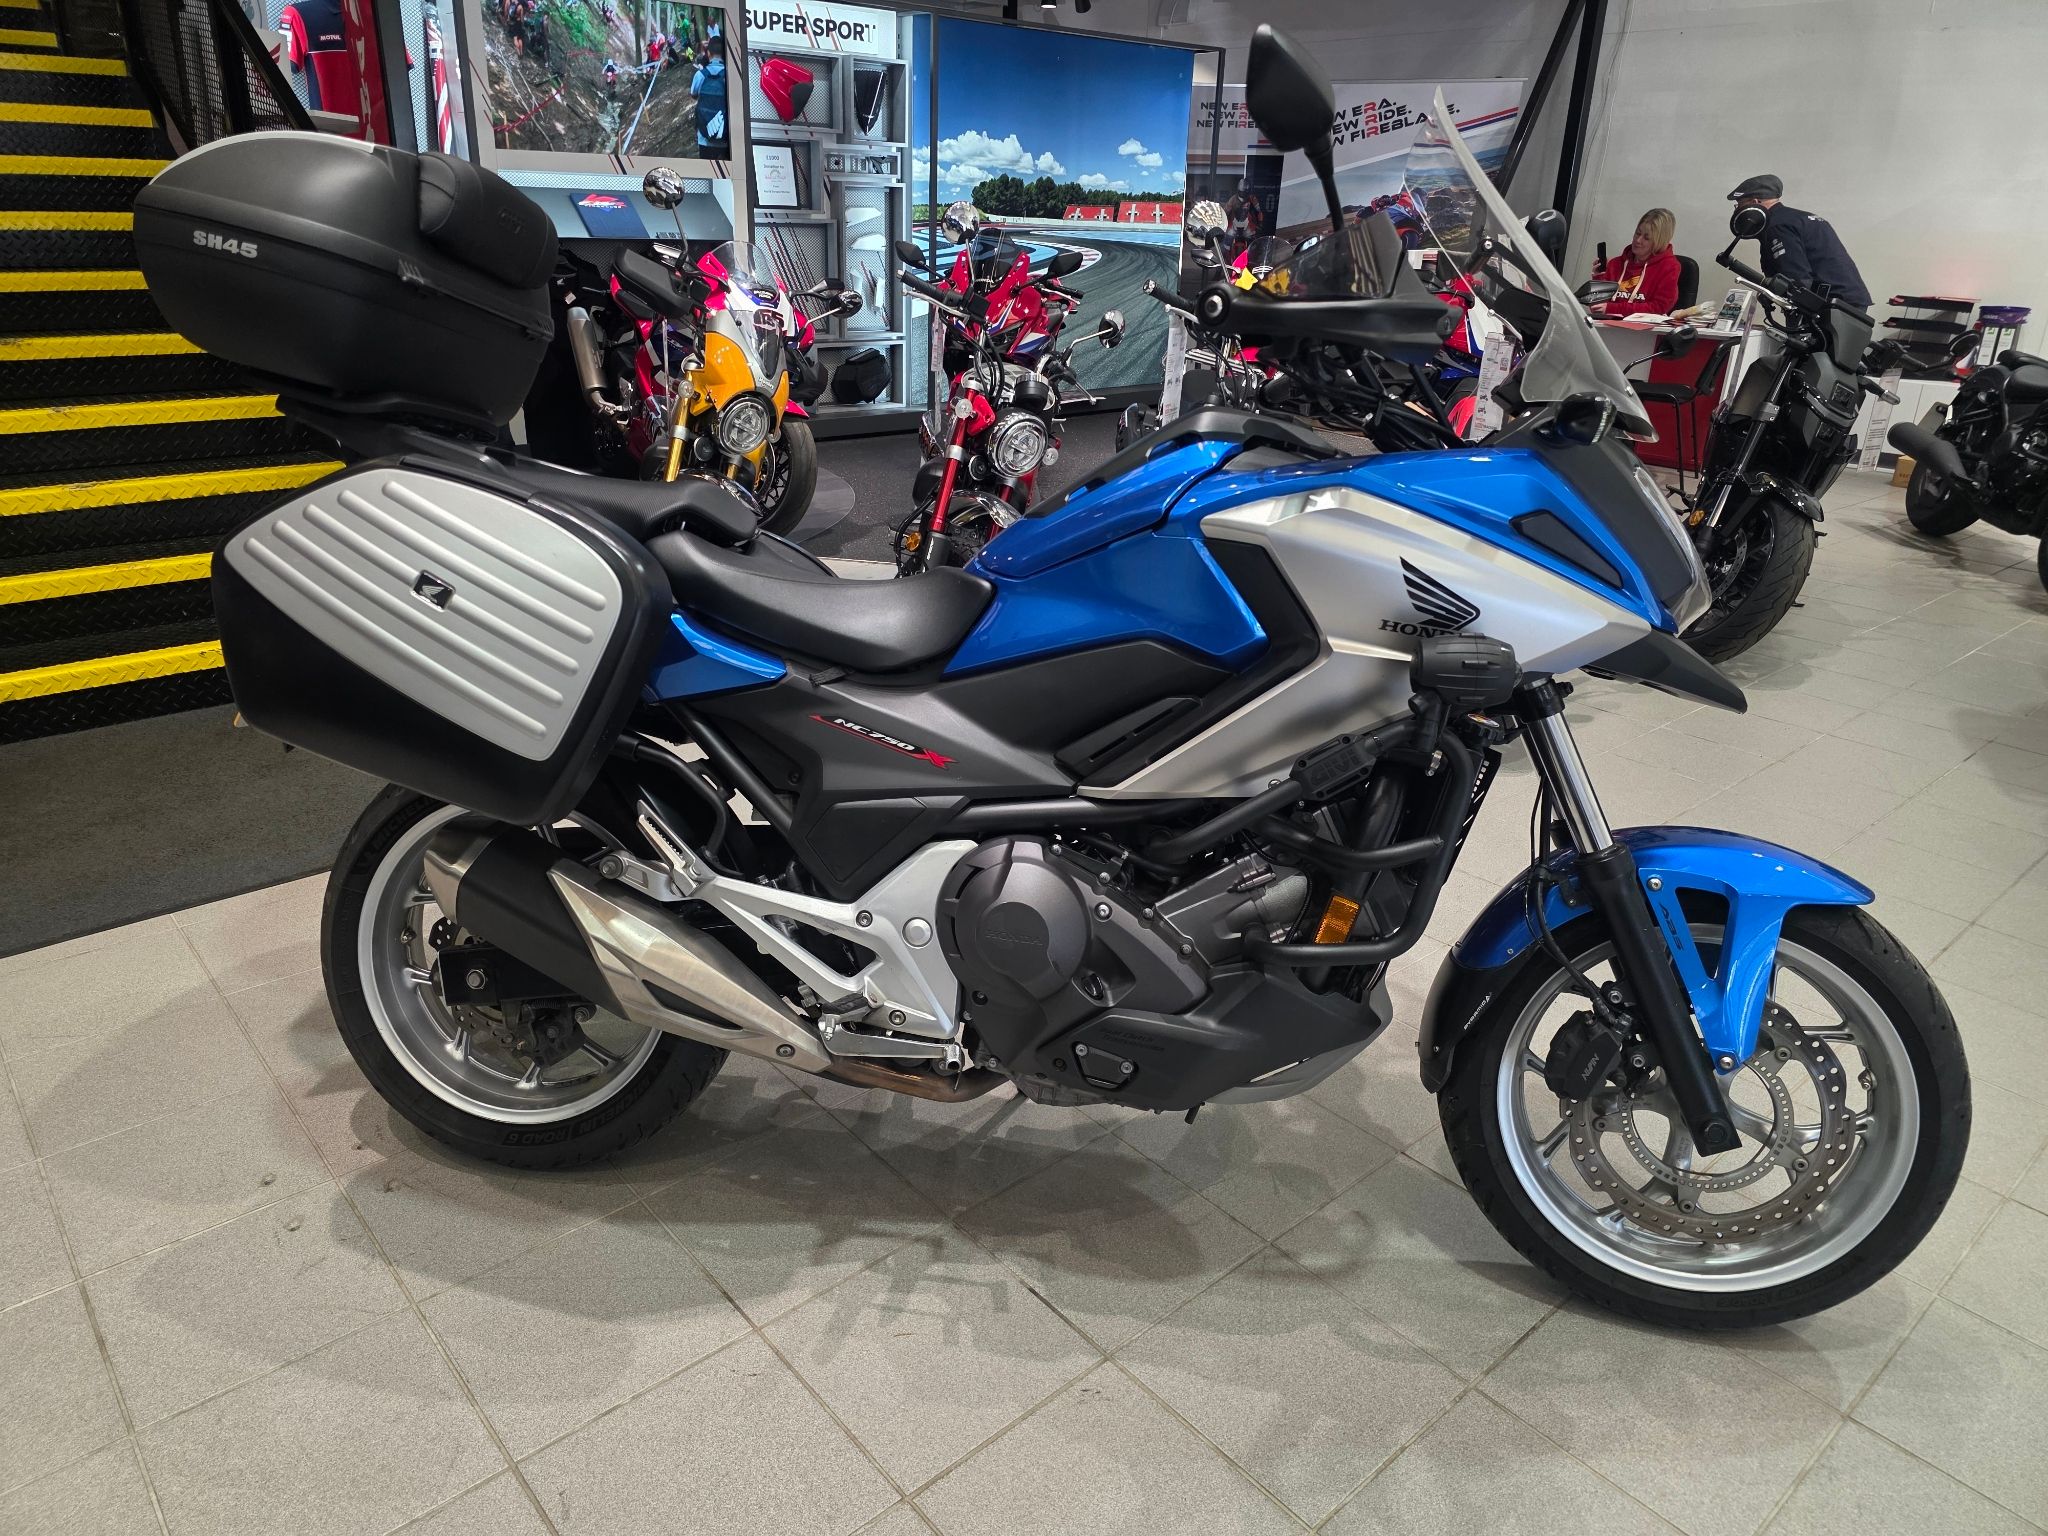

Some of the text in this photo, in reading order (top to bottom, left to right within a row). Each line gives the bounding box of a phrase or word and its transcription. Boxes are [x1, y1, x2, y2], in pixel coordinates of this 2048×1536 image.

[745, 9, 876, 44] SUPER SPORT
[1332, 118, 1359, 135] EW
[1364, 104, 1412, 126] RIDE.
[1350, 104, 1461, 143] FIREBLAE.
[1351, 98, 1397, 118] ERA.
[193, 230, 258, 258] SH45
[1658, 903, 1684, 950] ABS
